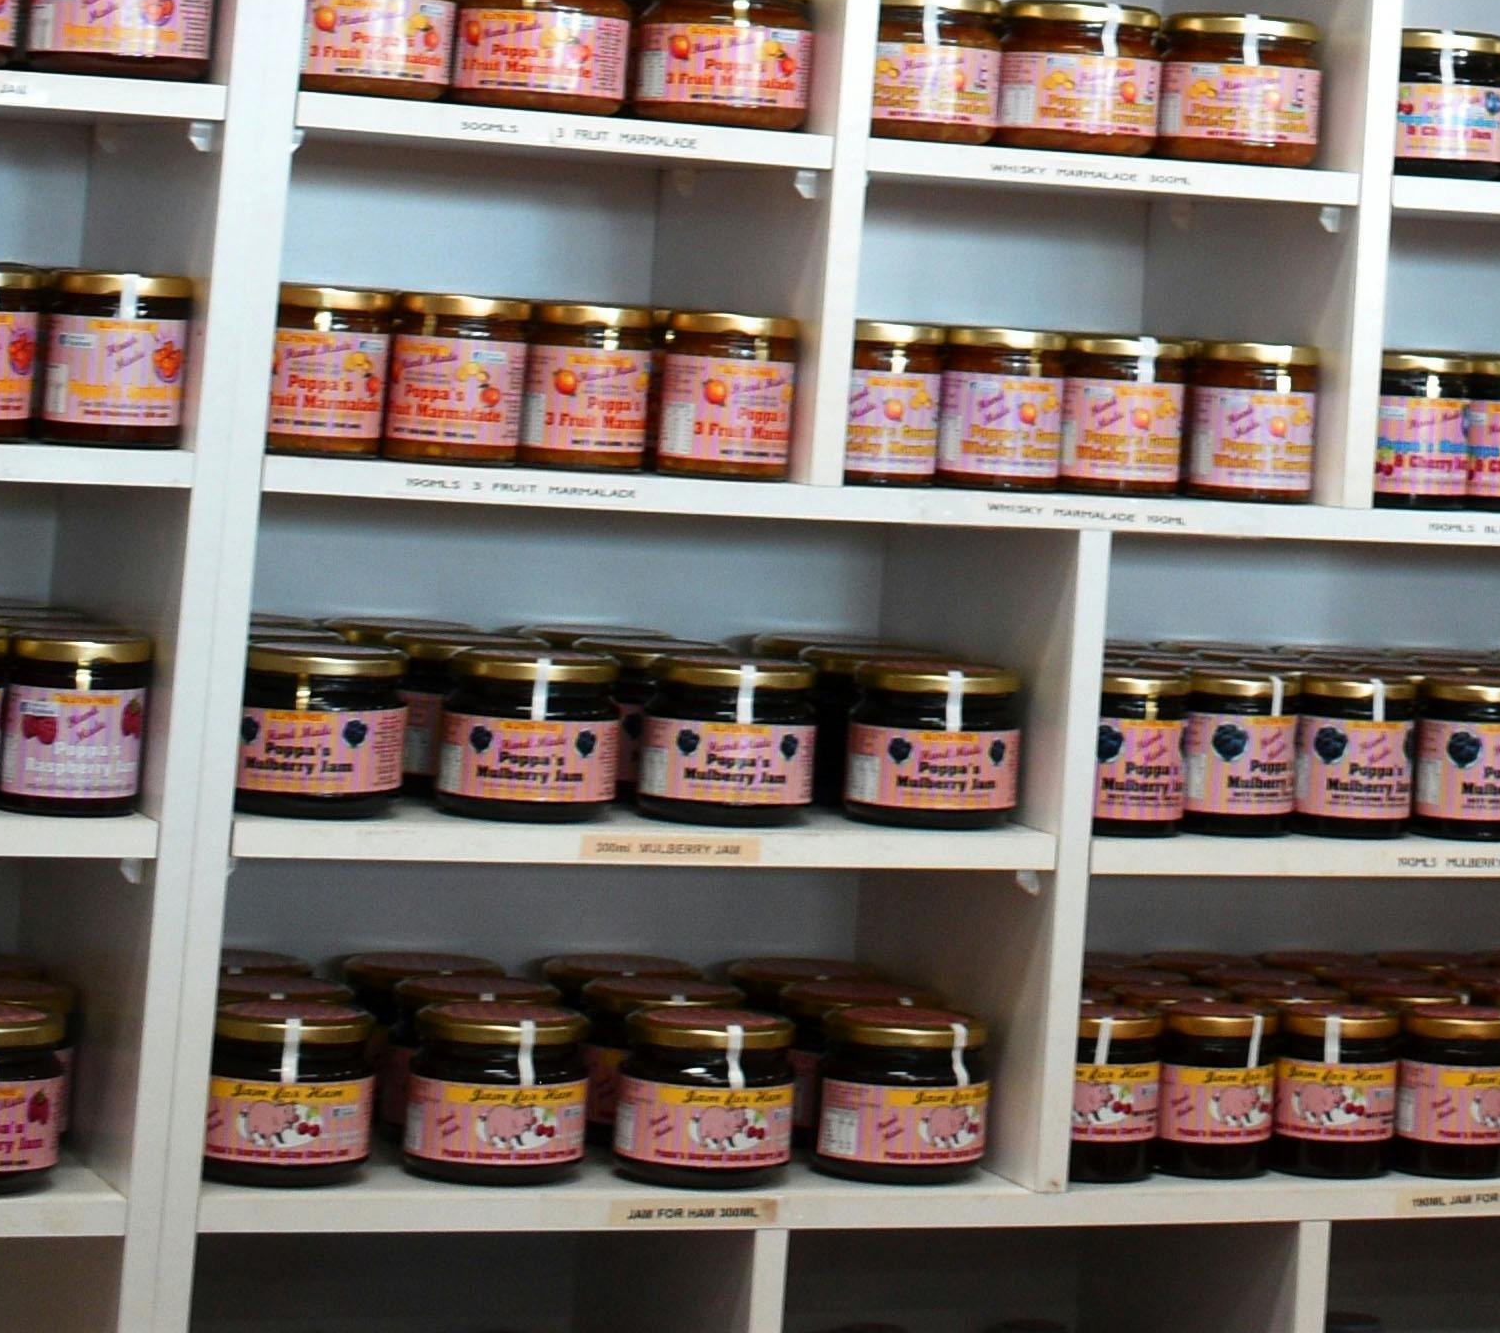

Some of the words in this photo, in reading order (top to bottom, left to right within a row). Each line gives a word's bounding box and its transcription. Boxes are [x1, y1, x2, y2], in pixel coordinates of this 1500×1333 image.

[574, 129, 608, 142] FRUIT
[619, 133, 698, 149] MARMALADE
[1055, 168, 1138, 182] MARMALADE
[491, 482, 537, 495] FRUIT
[548, 485, 637, 499] MARMALADE
[1053, 507, 1135, 522] MARMALADE
